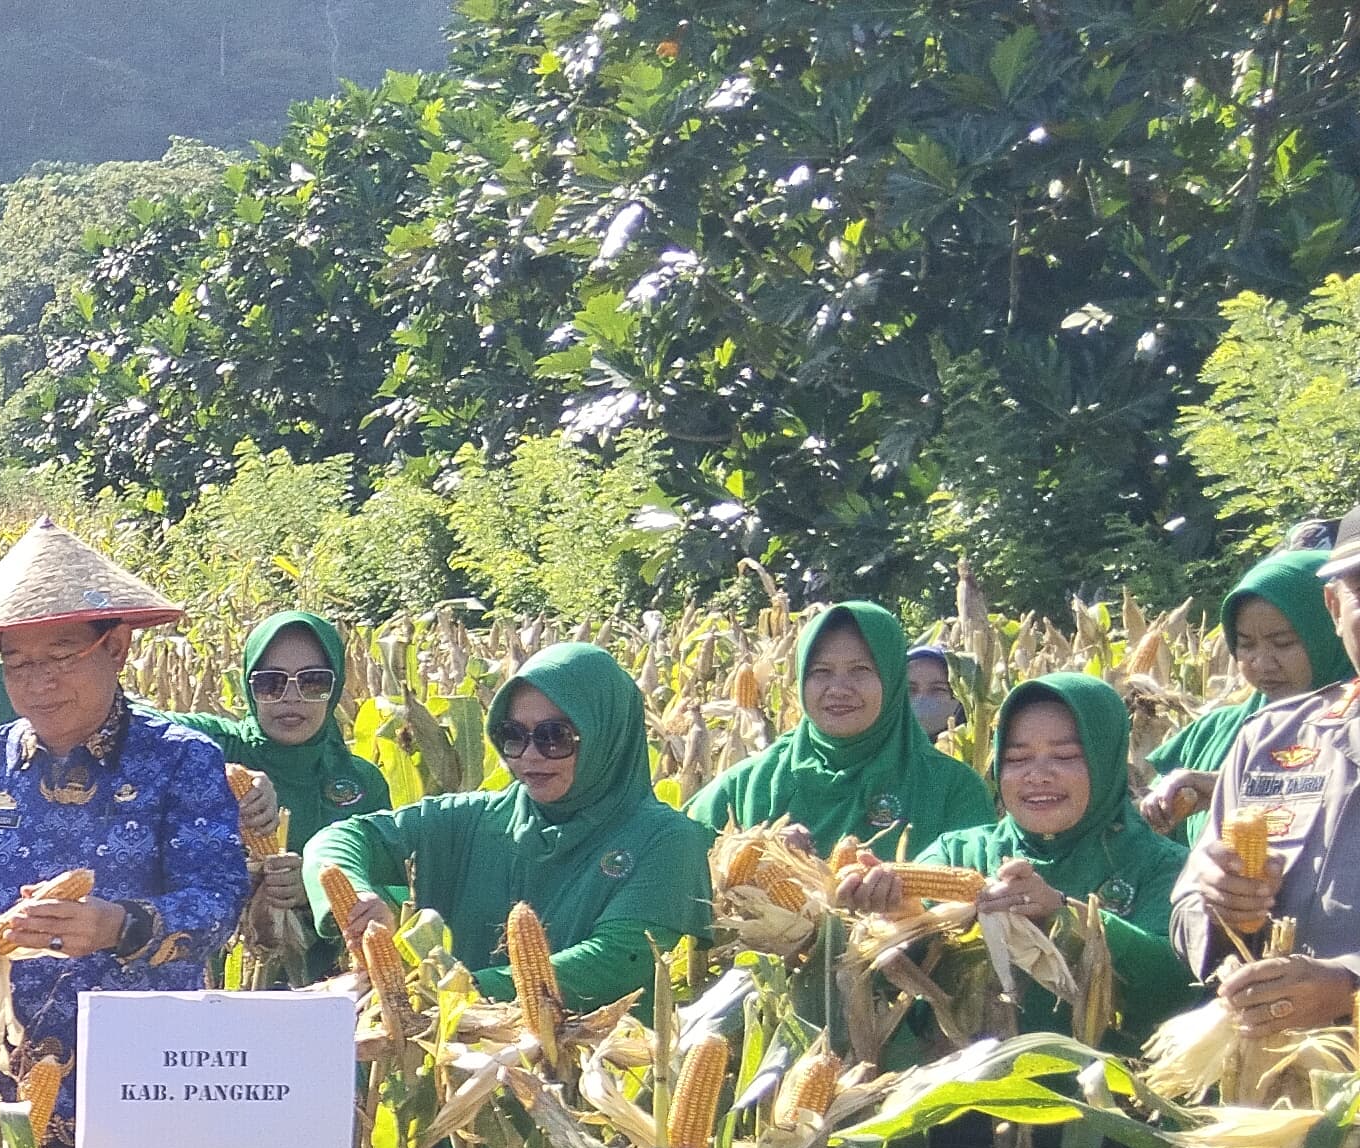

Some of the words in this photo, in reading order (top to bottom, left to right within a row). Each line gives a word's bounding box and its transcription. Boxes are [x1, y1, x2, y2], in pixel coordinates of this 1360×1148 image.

[163, 1050, 247, 1067] BUPATI
[121, 1084, 175, 1101] KAB.
[183, 1084, 290, 1101] PANGKEP
